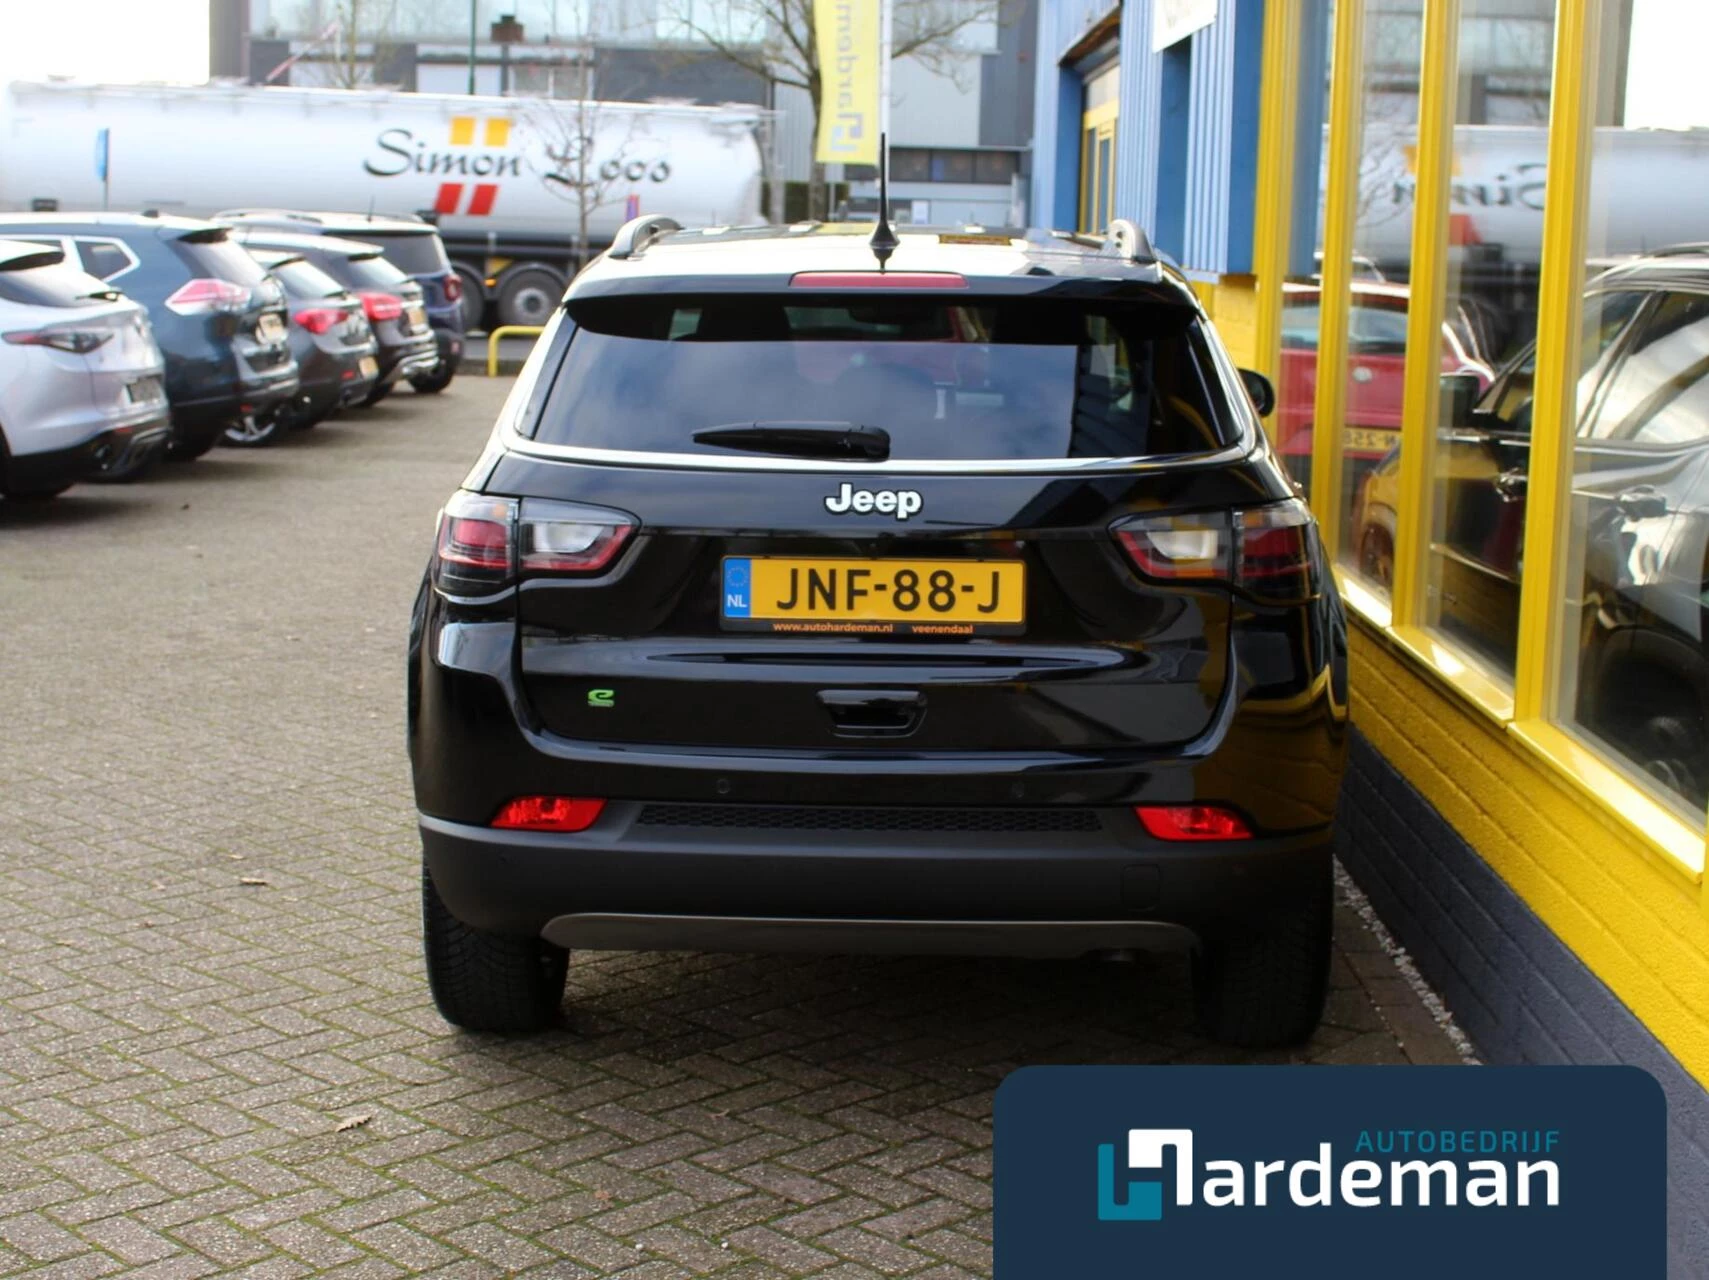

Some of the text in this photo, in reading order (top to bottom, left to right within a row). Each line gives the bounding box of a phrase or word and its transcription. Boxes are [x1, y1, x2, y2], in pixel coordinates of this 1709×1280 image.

[363, 128, 520, 177] Simon
[825, 483, 922, 519] Jeep
[727, 567, 999, 613] NL JNF-88-J
[773, 622, 974, 635] www.autohardeman.nl veenendaal
